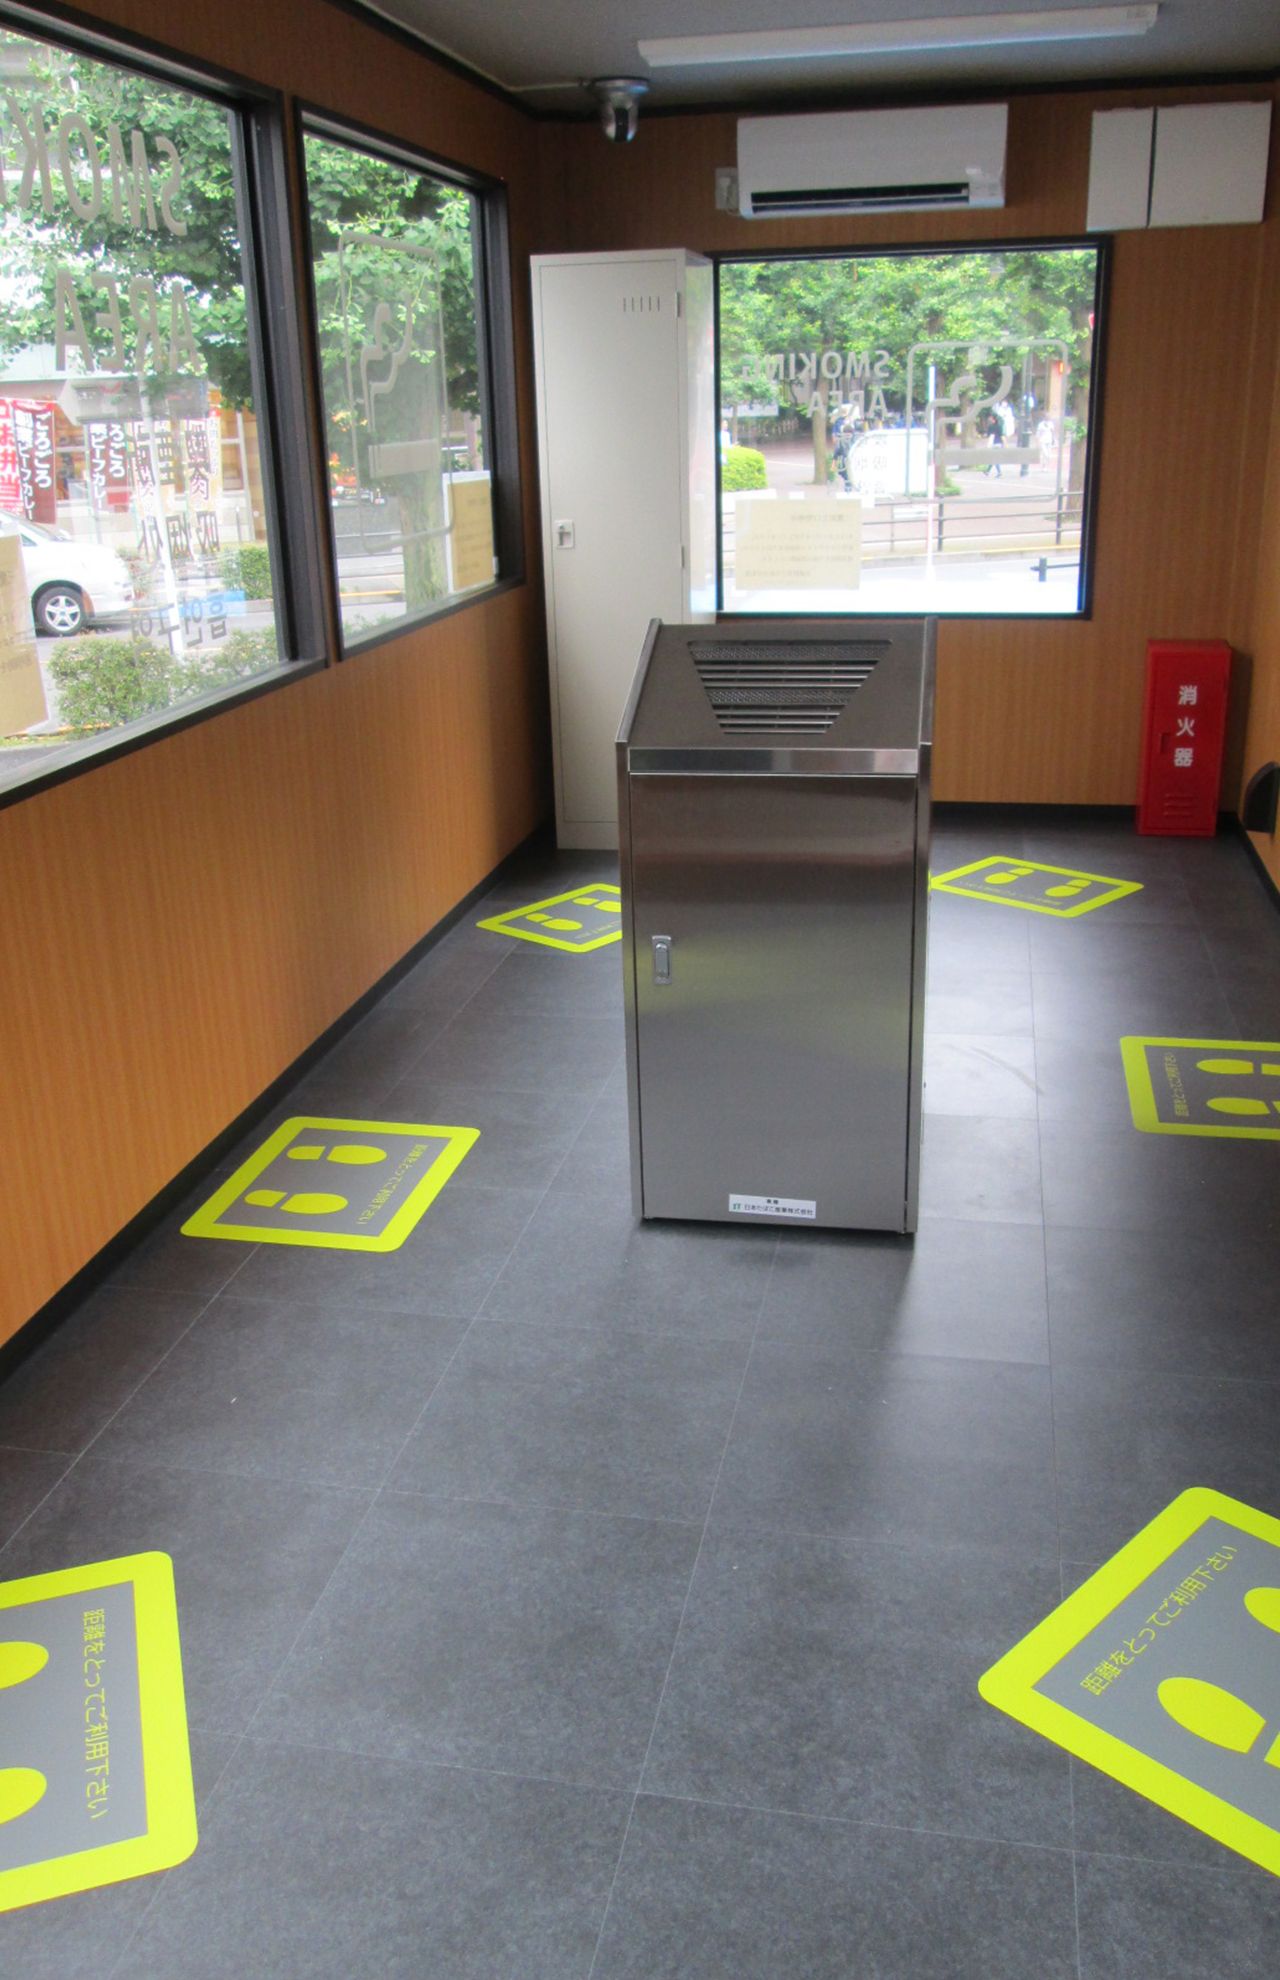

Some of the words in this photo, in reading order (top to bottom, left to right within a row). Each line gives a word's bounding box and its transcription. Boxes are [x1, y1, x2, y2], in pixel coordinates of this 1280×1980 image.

[34, 411, 53, 488] ごろごろ
[1173, 684, 1199, 768] 消火器
[1079, 1544, 1238, 1696] 距離をとってご利用下さい
[83, 1607, 111, 1820] 距離をとってご利用下さい
